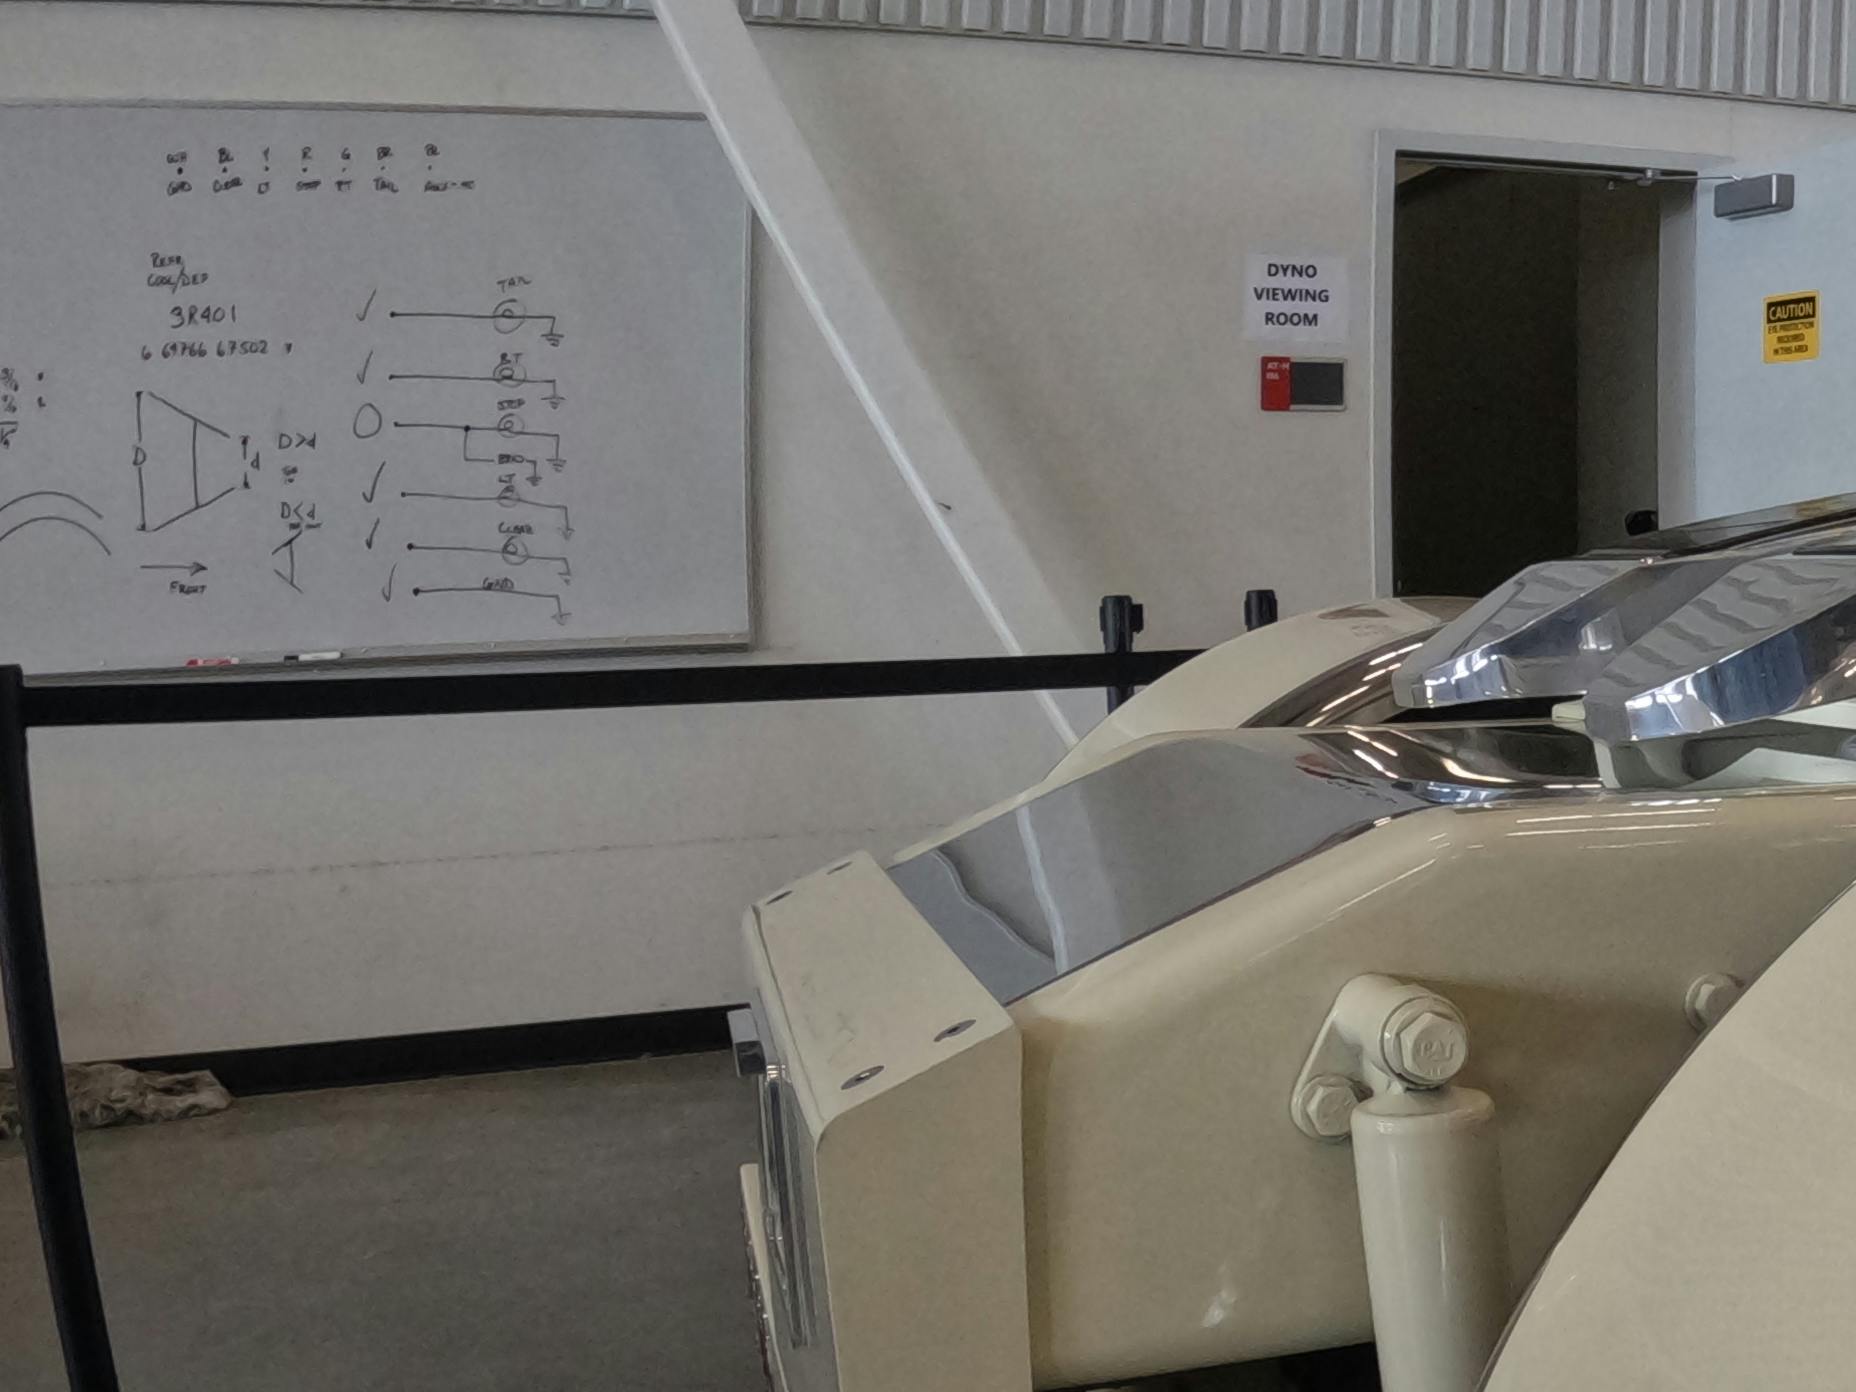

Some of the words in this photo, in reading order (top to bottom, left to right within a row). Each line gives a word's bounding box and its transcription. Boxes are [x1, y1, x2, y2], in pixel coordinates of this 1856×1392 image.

[1267, 263, 1318, 278] DYNO
[1253, 287, 1330, 303] VIEWING
[1769, 301, 1814, 321] CAUTION
[1265, 312, 1319, 327] ROOM
[132, 446, 147, 466] D
[250, 452, 260, 471] d
[169, 580, 207, 596] FRONT
